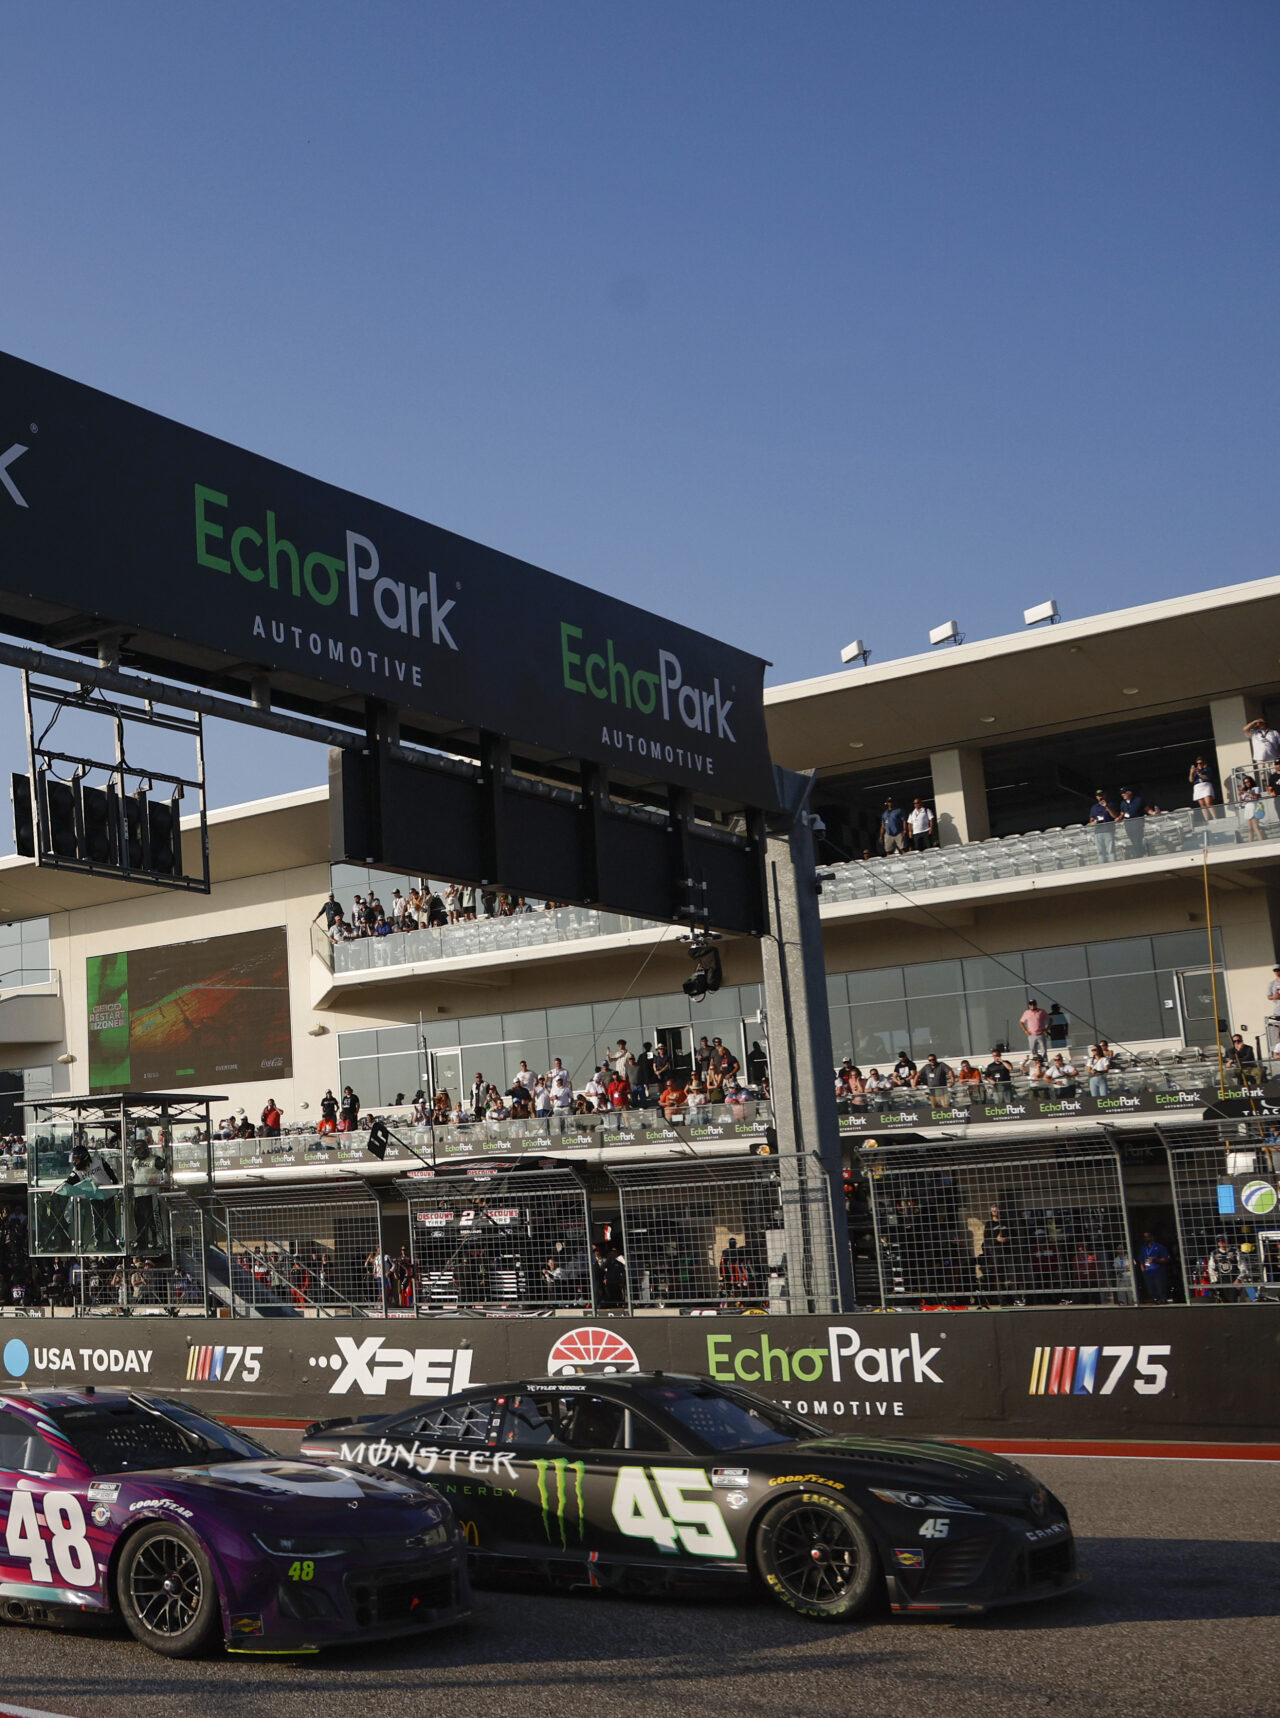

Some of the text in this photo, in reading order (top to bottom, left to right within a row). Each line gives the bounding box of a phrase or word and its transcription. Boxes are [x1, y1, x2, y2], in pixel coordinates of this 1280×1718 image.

[194, 482, 460, 652] EchoPark
[253, 615, 423, 688] AUTOMOTIVE
[560, 621, 738, 744] EchoPark
[601, 725, 715, 776] AUTOMOTIVE
[89, 1010, 126, 1023] RESTART
[1097, 1096, 1141, 1109] EchoPark
[1155, 1091, 1201, 1104] EchoPark
[931, 1108, 970, 1120] EchoPark
[985, 1104, 1026, 1116] EchoPark
[1040, 1101, 1082, 1113] EchoPark
[880, 1112, 919, 1124] EchoPark
[603, 1131, 635, 1143] EchoPark
[690, 1123, 724, 1137] EchoPark
[445, 1142, 474, 1152] EchoPark
[482, 1140, 511, 1150] EchoPark
[561, 1135, 593, 1145] EchoPark
[417, 1212, 454, 1221] DISCOUNT
[460, 1210, 476, 1226] 2
[33, 1347, 154, 1374] USA TODAY
[706, 1326, 945, 1384] EchoPark
[223, 1346, 264, 1383] 75
[329, 1336, 486, 1396] XPEL
[1098, 1344, 1172, 1396] 75
[775, 1399, 905, 1417] TOMOTIVE
[768, 1474, 846, 1490] GOODYEAR
[129, 1498, 194, 1519] GOODYEAR
[801, 1493, 846, 1511] EAGLE
[612, 1466, 738, 1560] 45
[918, 1518, 950, 1539] 45
[1024, 1521, 1067, 1542] CAMRY
[5, 1489, 97, 1588] 48
[288, 1560, 315, 1582] 48
